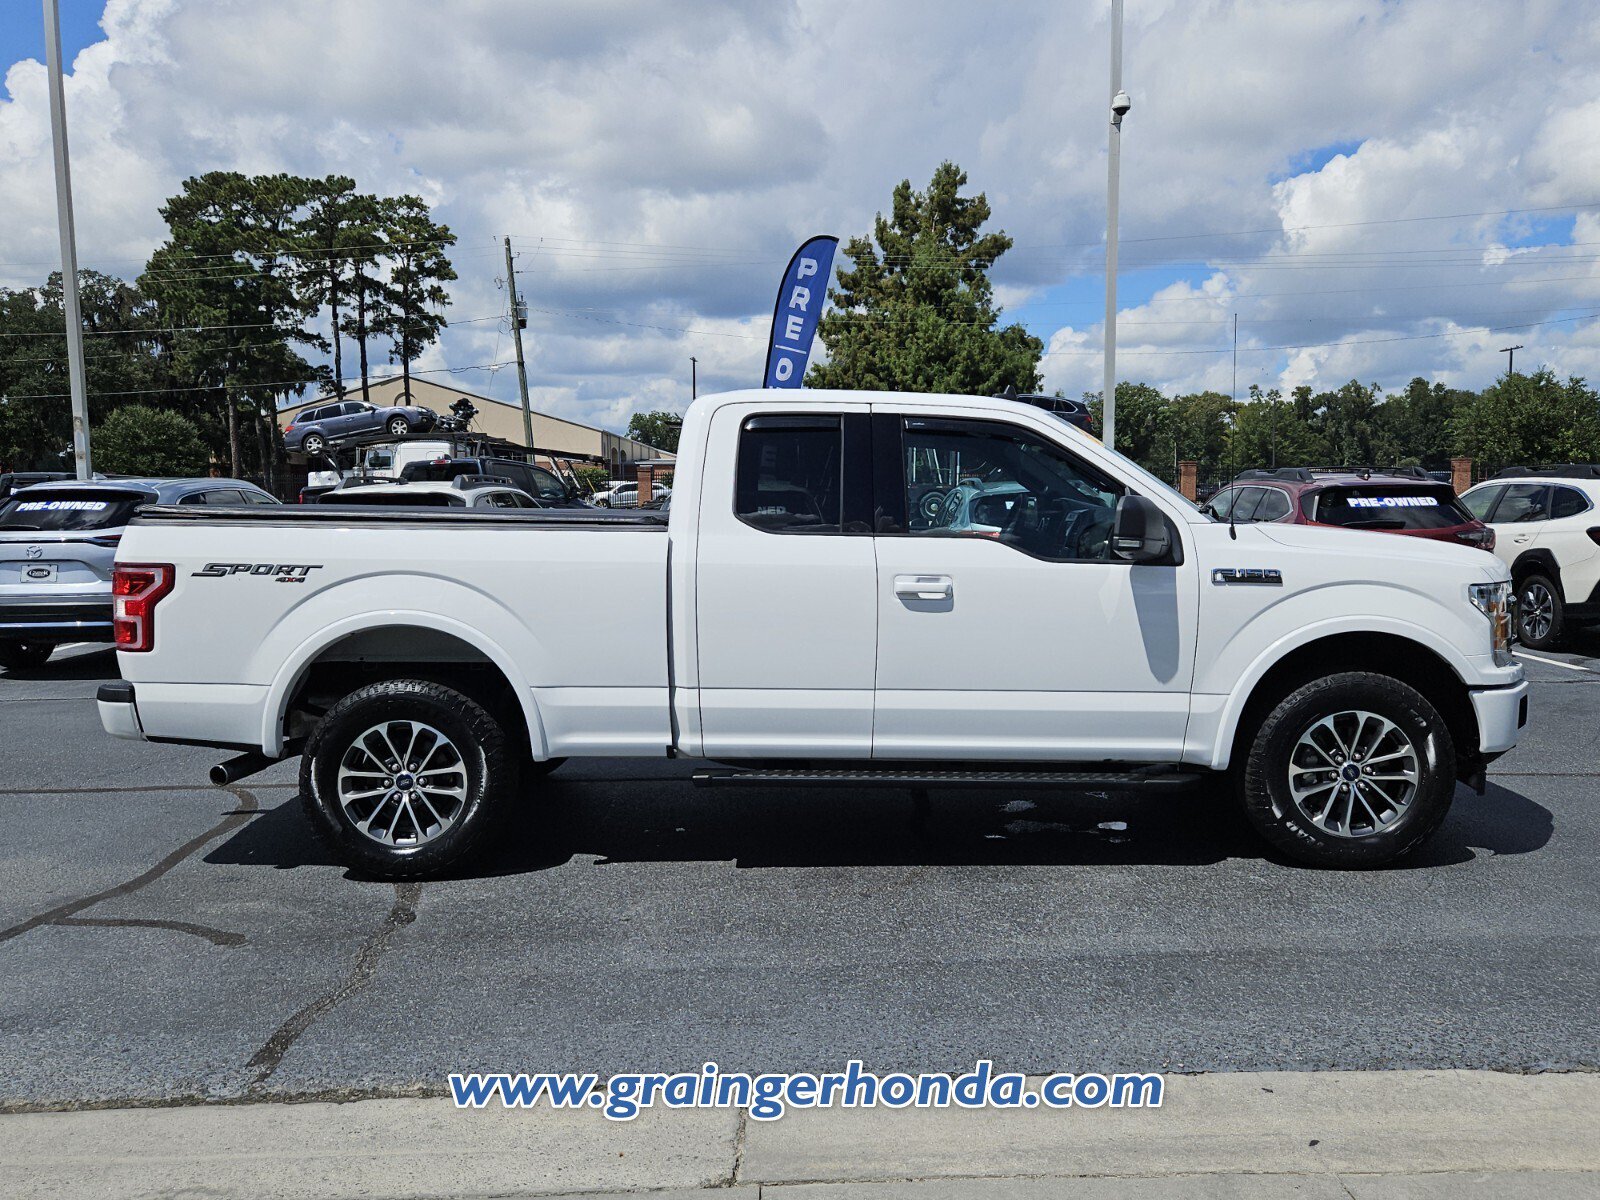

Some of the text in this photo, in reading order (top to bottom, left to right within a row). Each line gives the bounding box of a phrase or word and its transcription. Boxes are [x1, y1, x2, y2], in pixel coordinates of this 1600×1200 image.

[15, 501, 107, 512] PRE-OWNED
[1346, 496, 1439, 508] PRE-OWNED
[191, 563, 324, 577] SPORT
